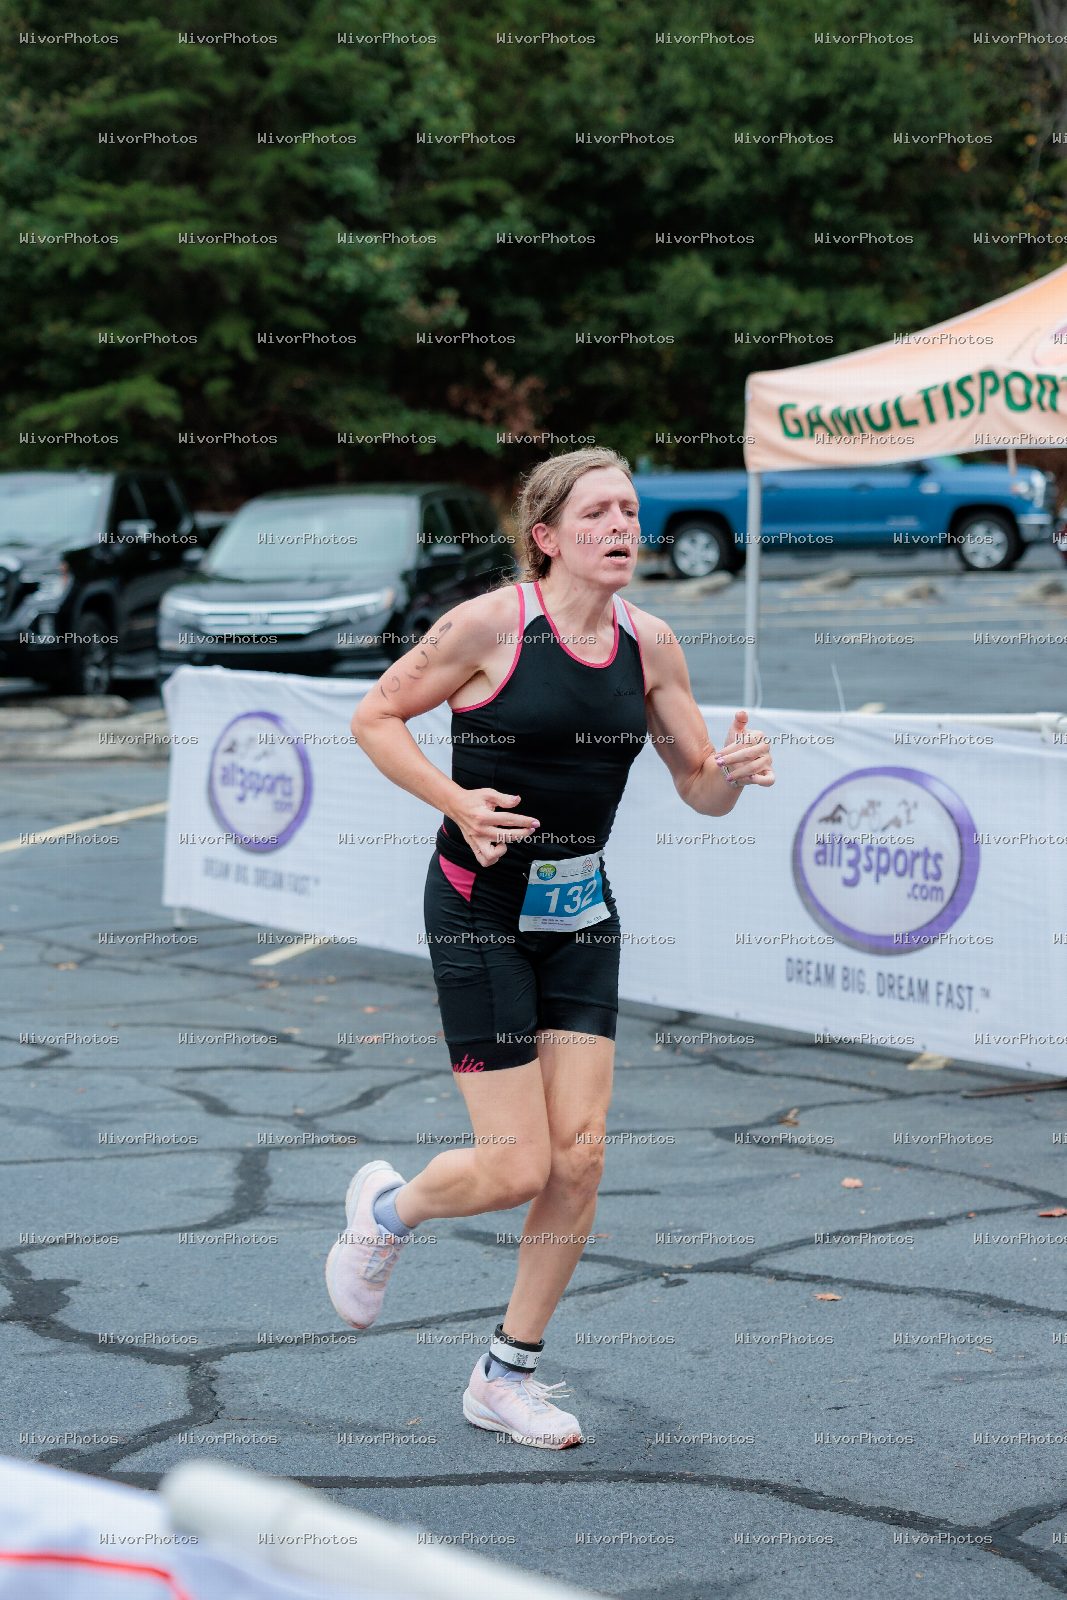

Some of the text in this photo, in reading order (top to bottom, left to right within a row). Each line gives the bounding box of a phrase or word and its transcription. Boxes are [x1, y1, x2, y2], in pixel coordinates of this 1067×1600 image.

[778, 368, 1067, 439] GAMULTISPOR
[813, 832, 944, 888] all3sports
[545, 880, 597, 914] 132
[785, 956, 837, 989] DREAM
[841, 966, 871, 996] BIG.
[876, 971, 930, 1005] DREAM
